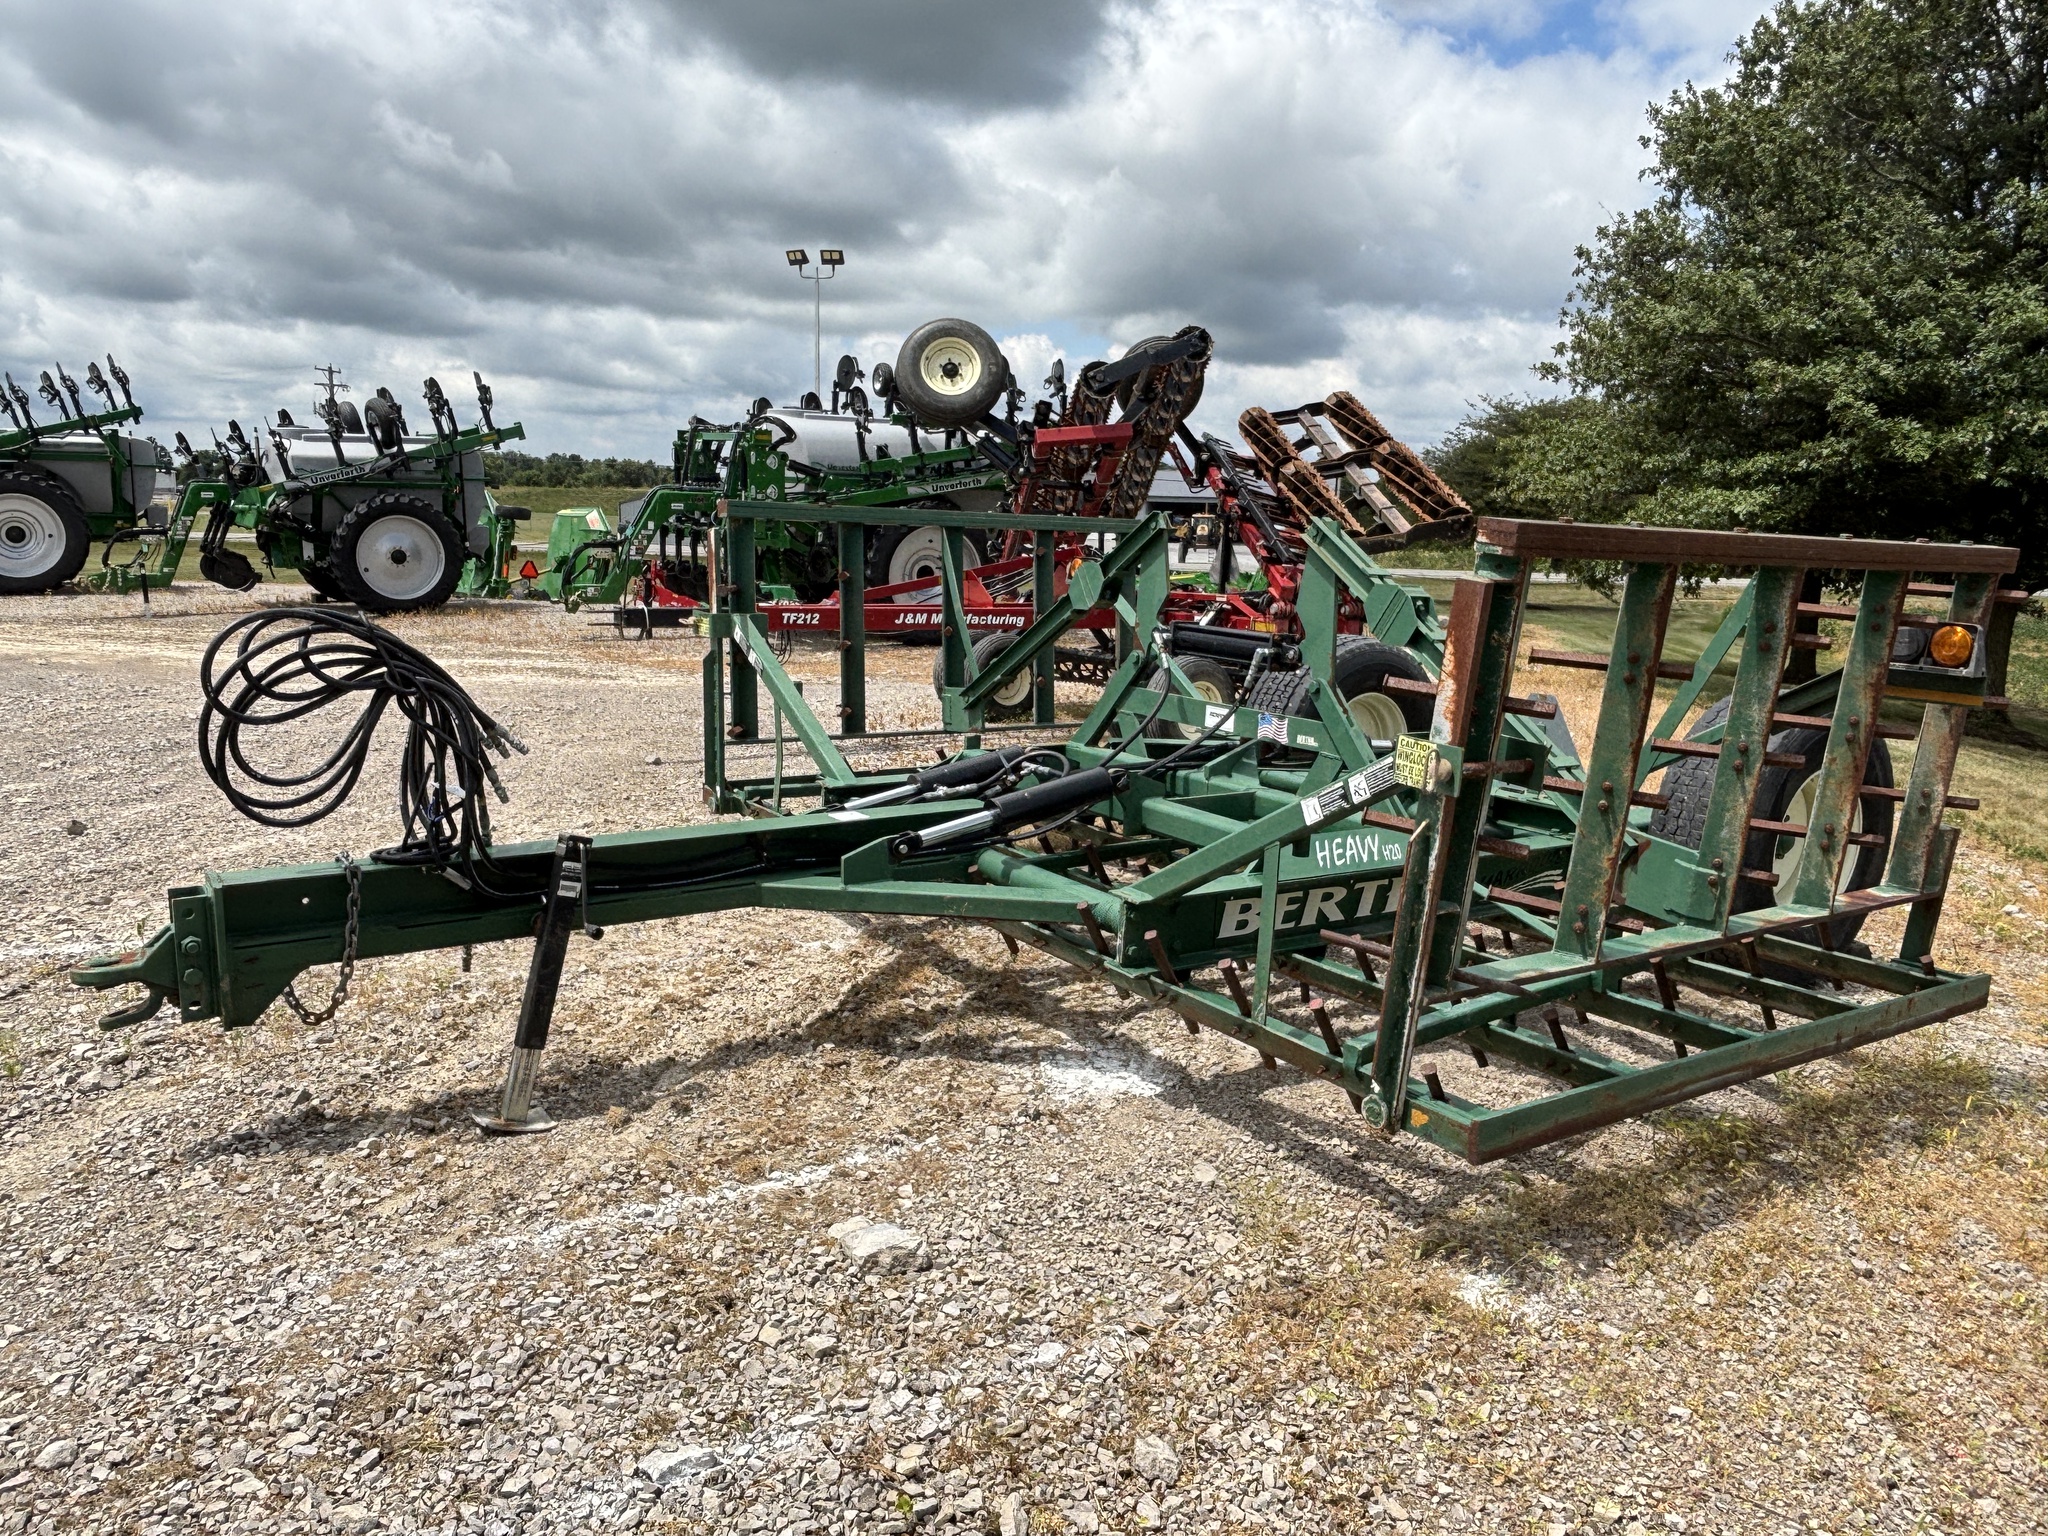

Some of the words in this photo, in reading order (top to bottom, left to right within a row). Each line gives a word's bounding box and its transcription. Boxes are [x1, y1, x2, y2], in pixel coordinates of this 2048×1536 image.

[781, 612, 821, 625] TF212
[894, 612, 928, 625] J&M
[930, 612, 1025, 627] Mfacturing
[1315, 833, 1379, 869] HEAVY
